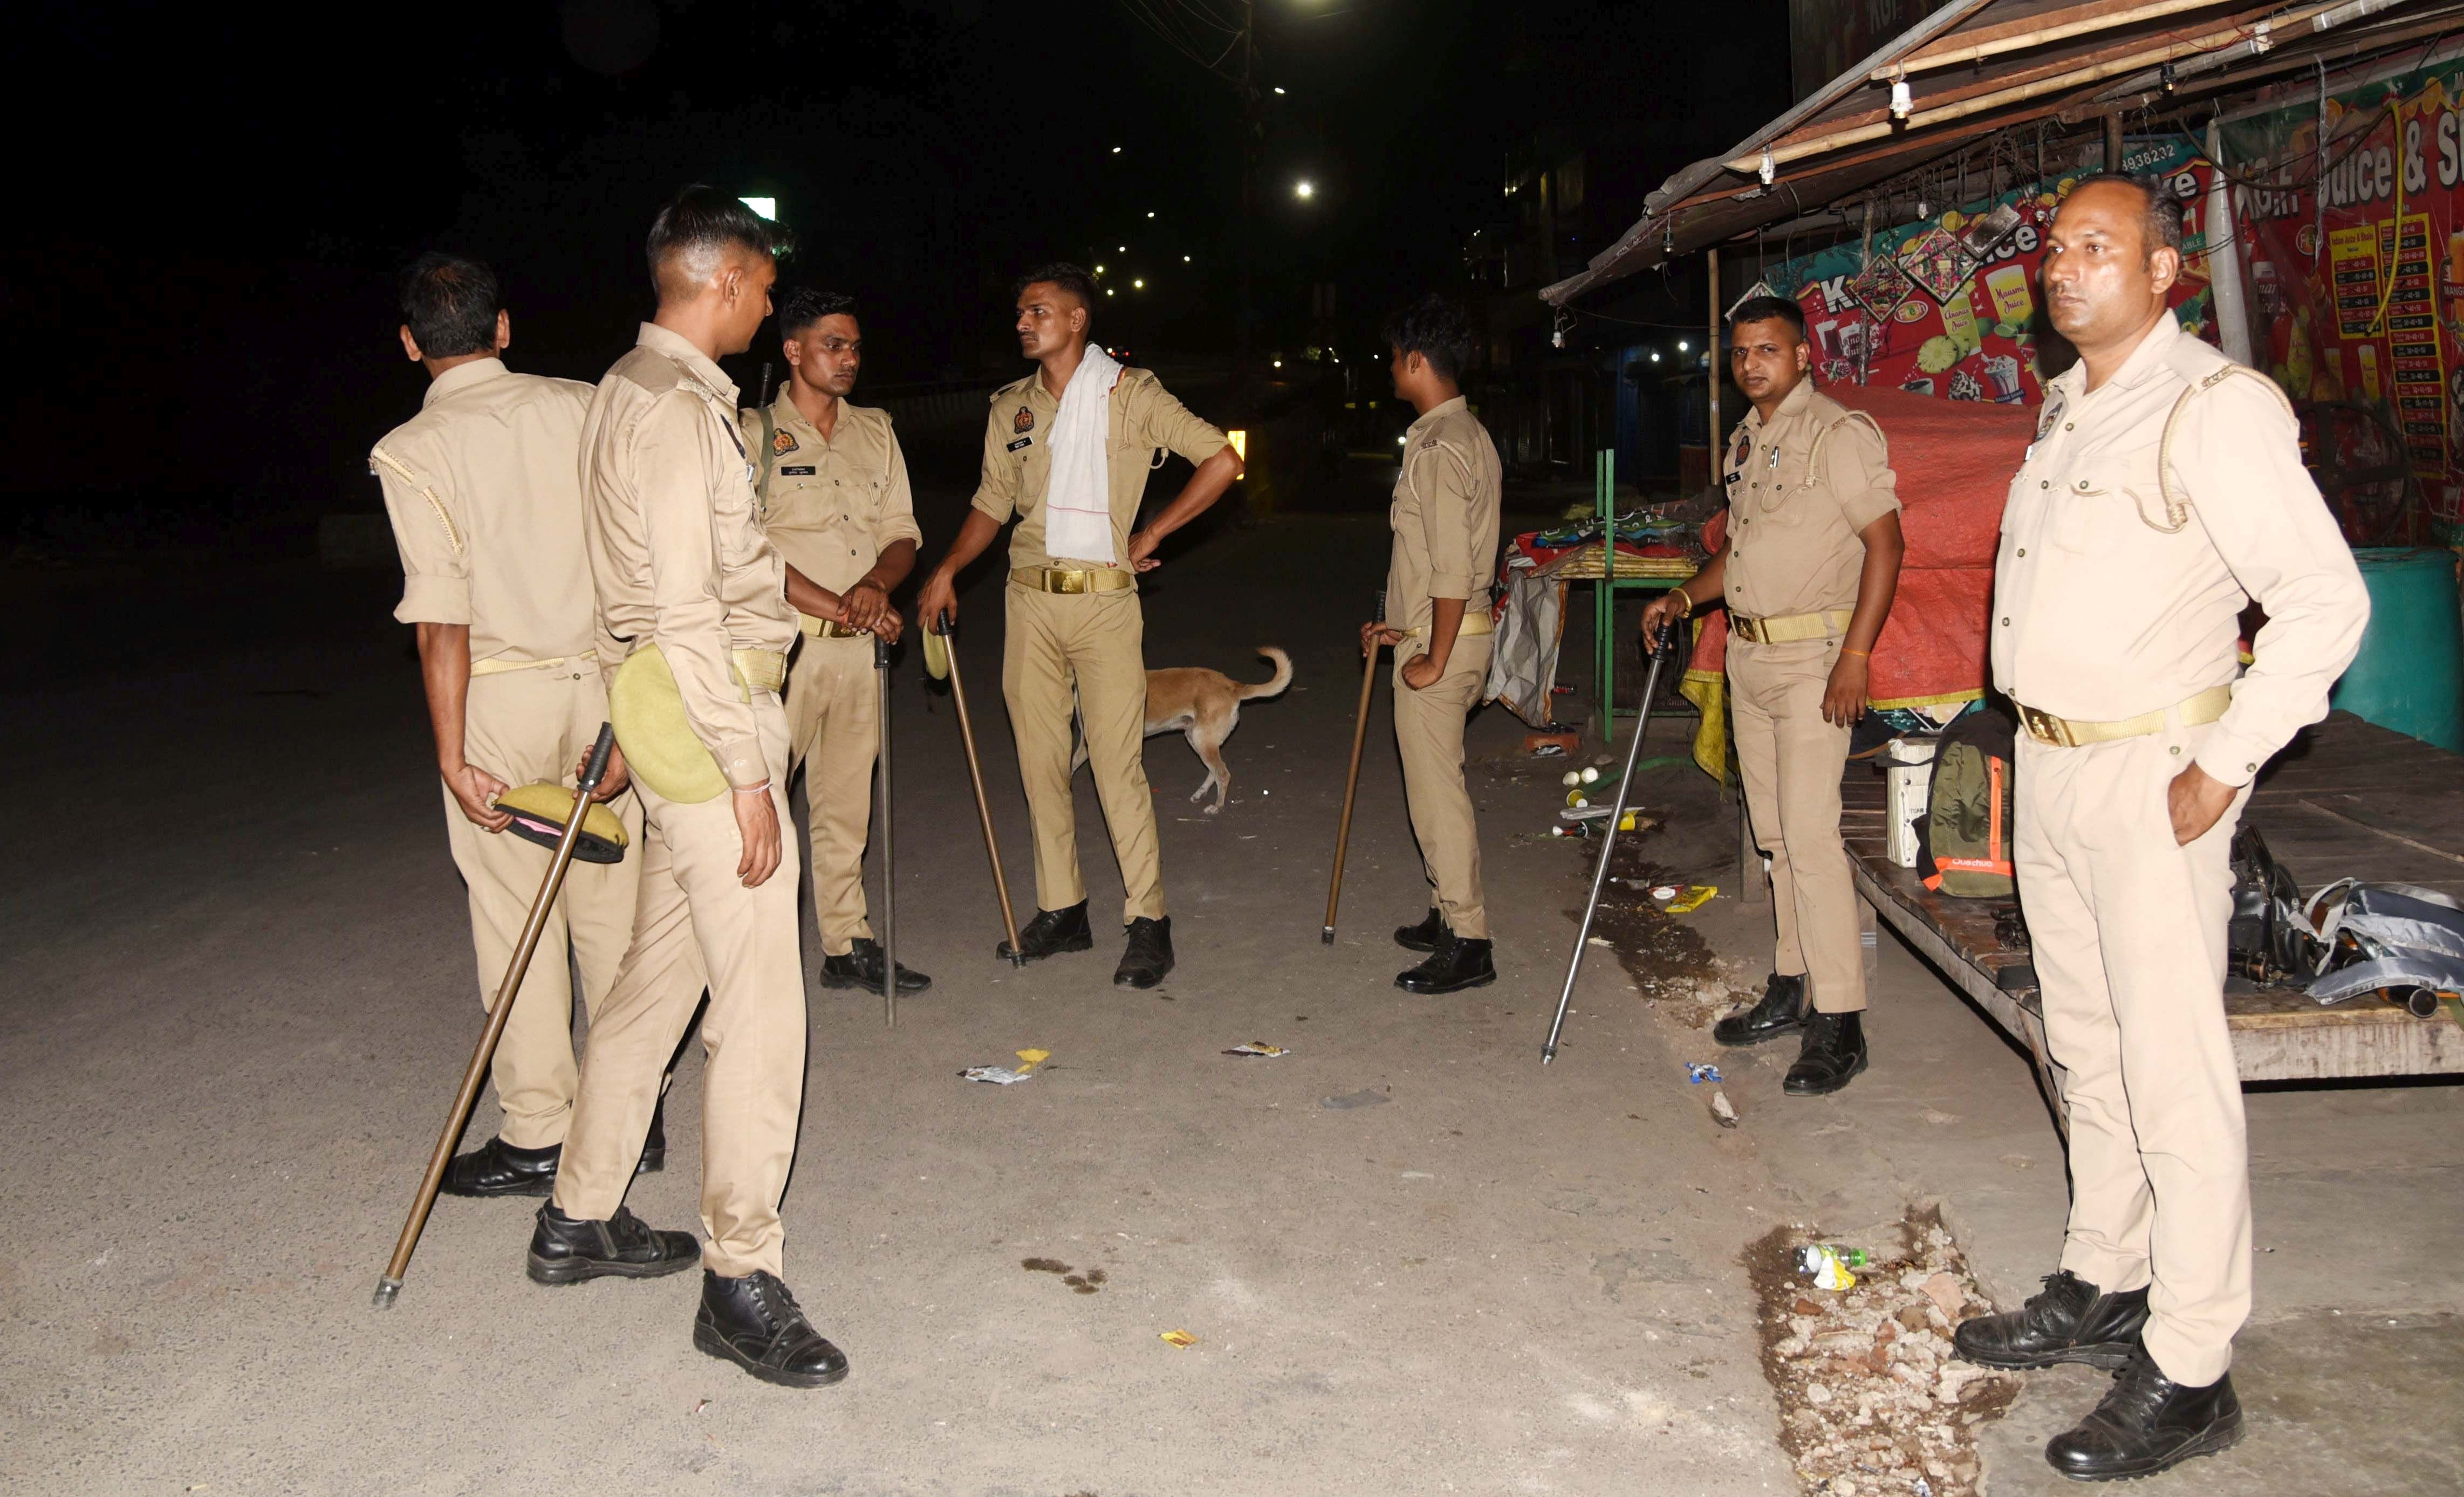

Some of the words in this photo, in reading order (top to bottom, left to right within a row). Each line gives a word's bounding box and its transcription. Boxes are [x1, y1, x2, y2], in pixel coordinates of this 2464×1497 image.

[2404, 120, 2426, 193] &
[2437, 111, 2464, 186] S
[1995, 284, 2025, 301] Mausmi
[2444, 285, 2464, 297] MANG
[2004, 299, 2024, 314] Juice
[1952, 320, 1969, 333] Juice
[1843, 335, 1860, 346] Ana
[1952, 858, 1993, 867] Quechua
